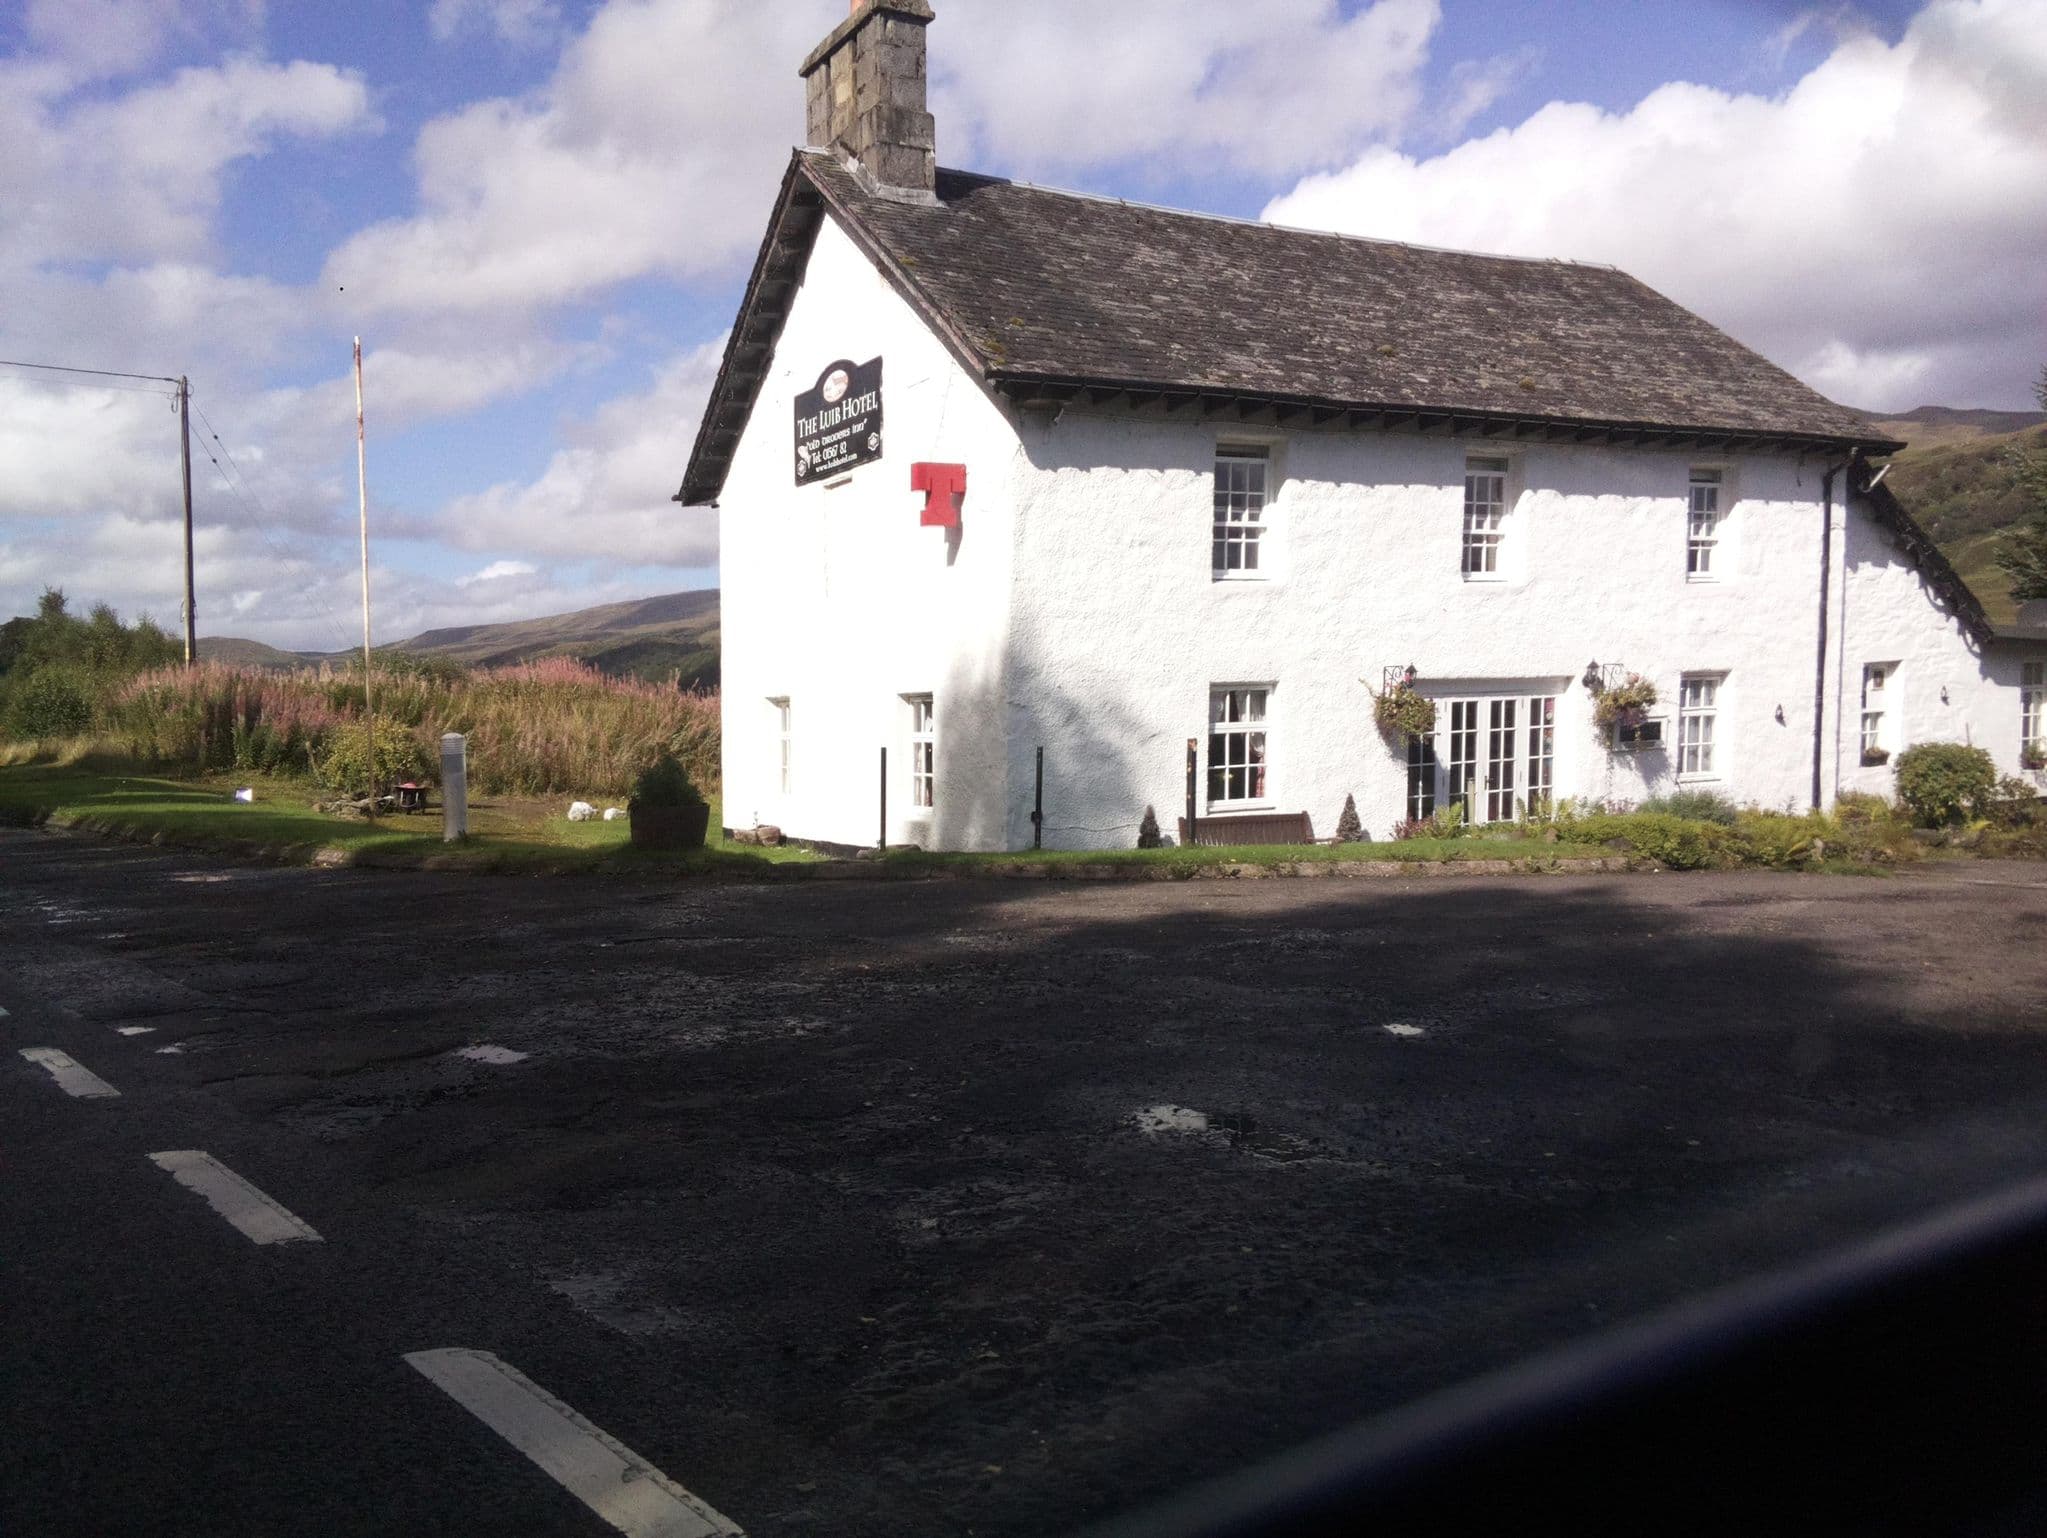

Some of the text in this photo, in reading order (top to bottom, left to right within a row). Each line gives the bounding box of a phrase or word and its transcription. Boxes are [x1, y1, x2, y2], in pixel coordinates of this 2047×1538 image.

[797, 391, 878, 438] THE LUIB HOTEL
